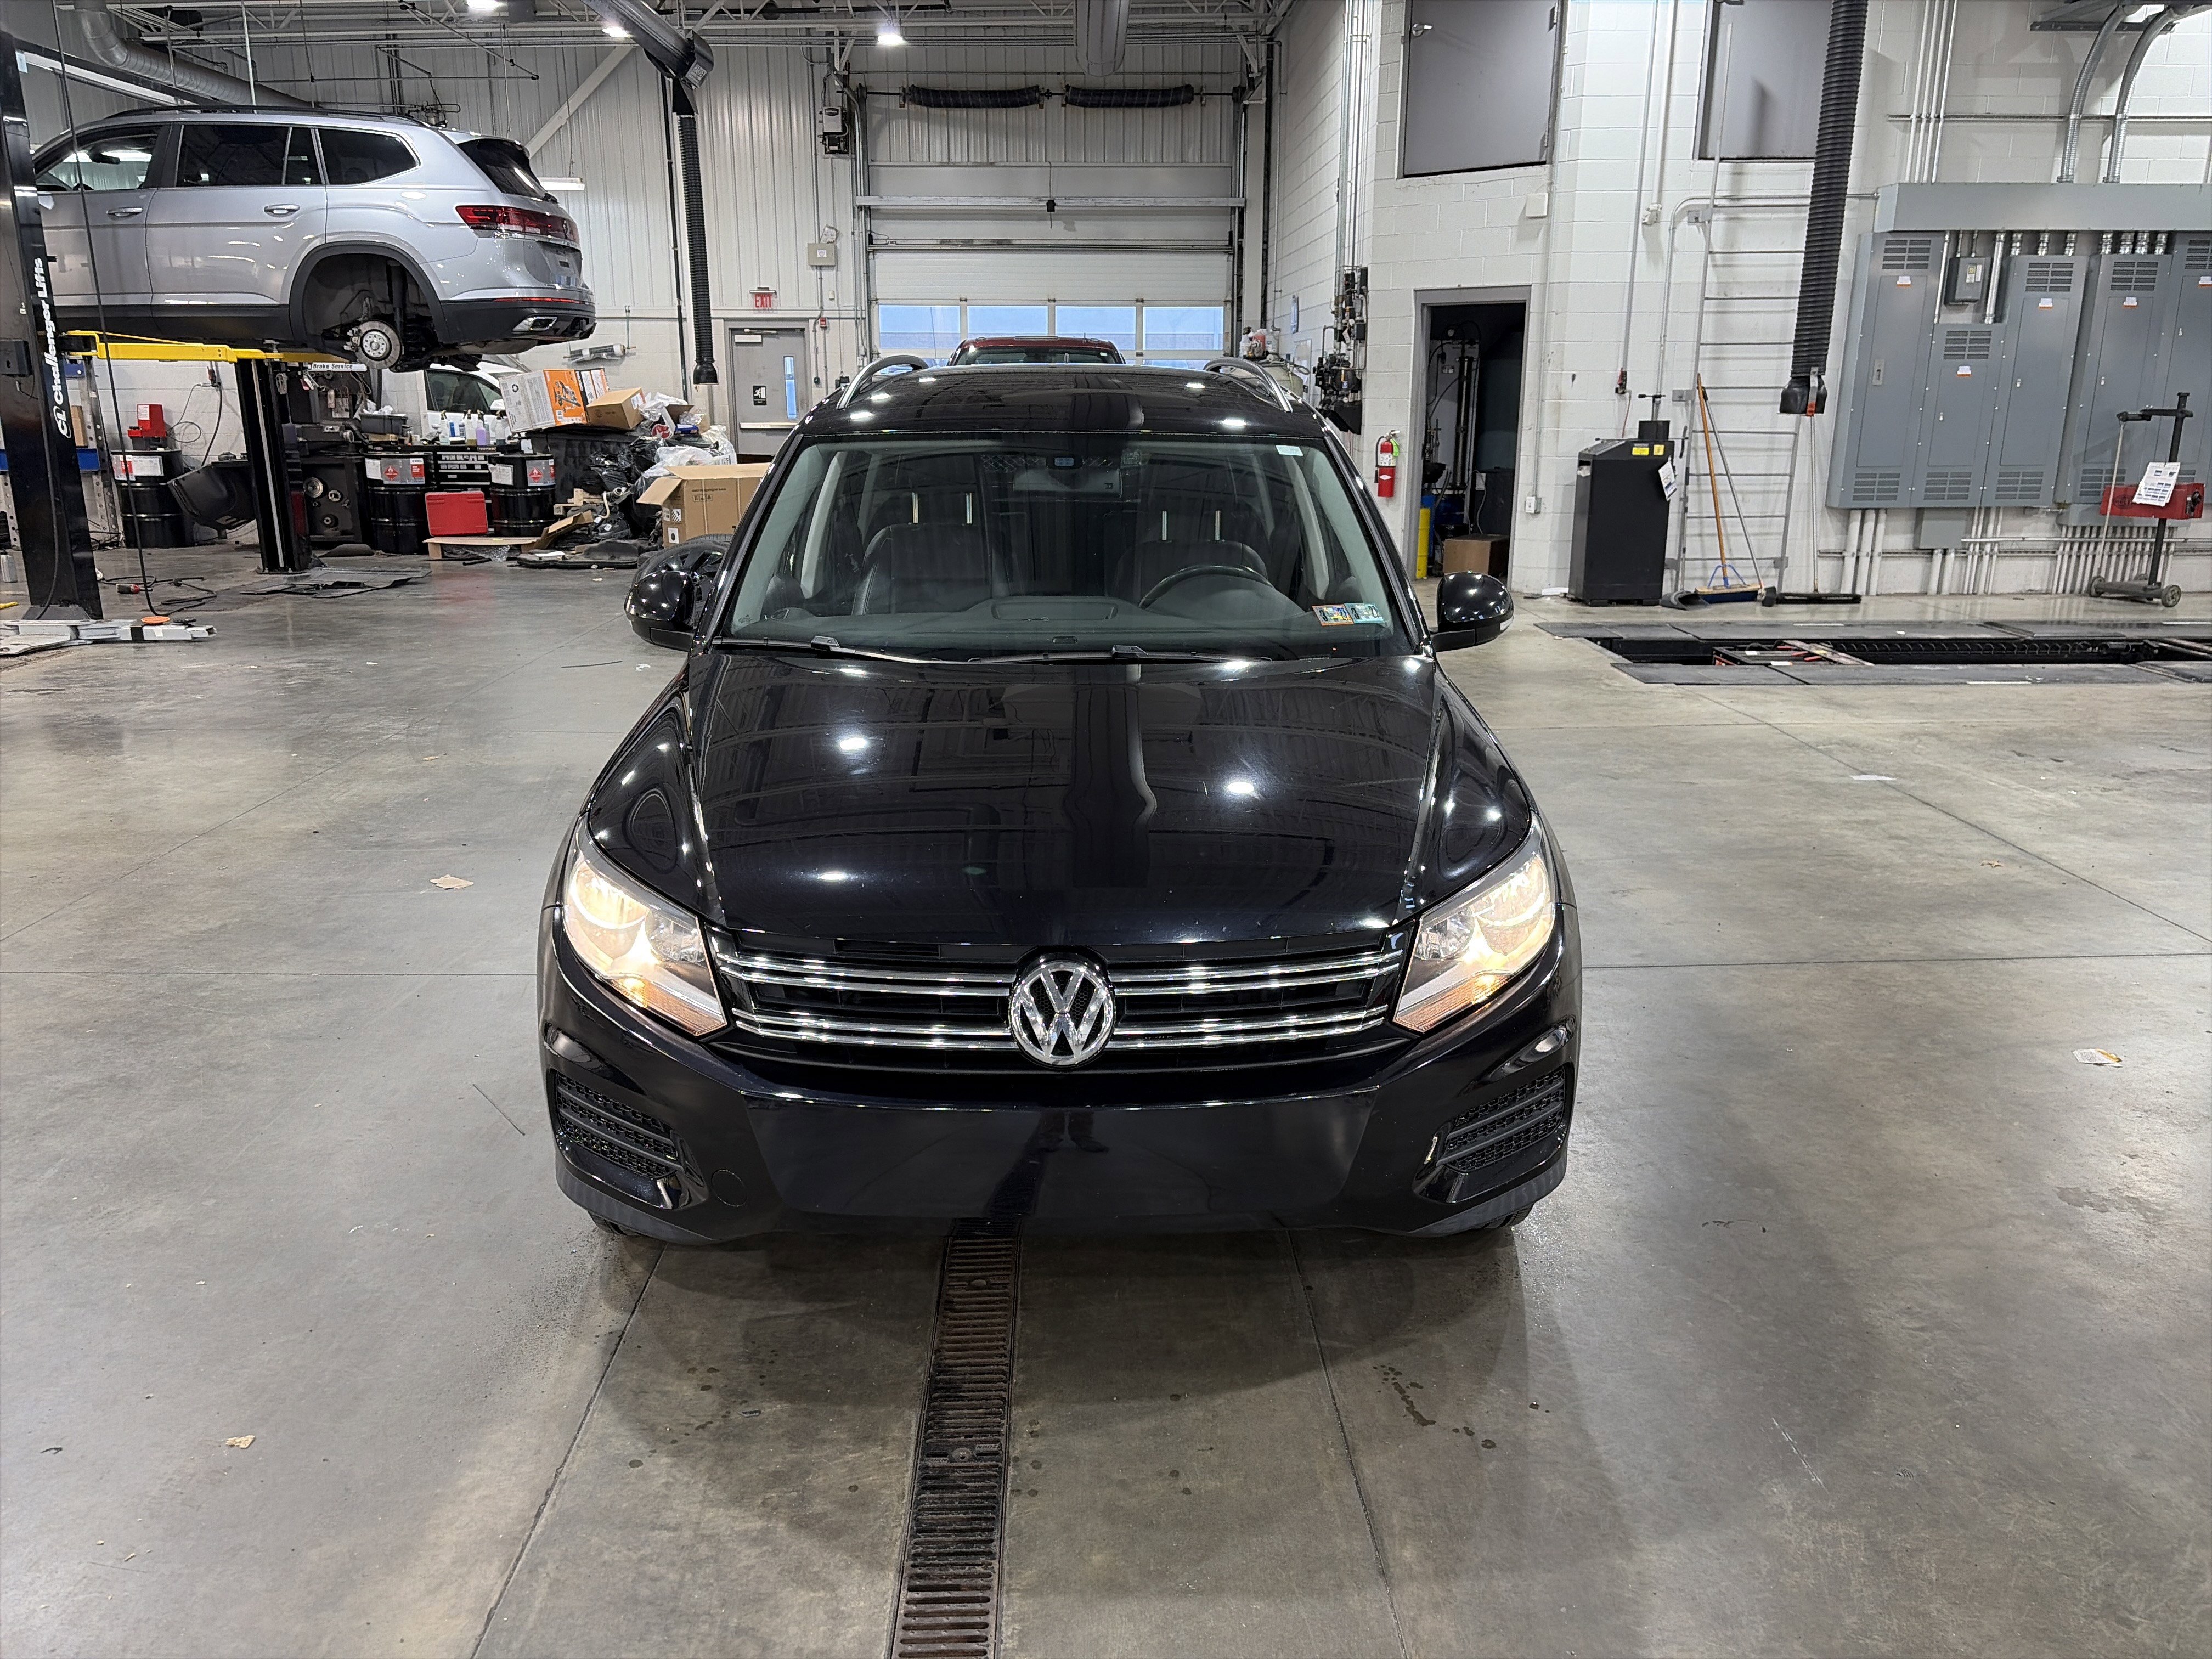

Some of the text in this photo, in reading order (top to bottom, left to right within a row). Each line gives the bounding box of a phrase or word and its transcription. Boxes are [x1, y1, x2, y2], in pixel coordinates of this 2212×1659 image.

[34, 257, 48, 298] Lifts
[755, 294, 772, 307] EXIT
[41, 300, 63, 405] Challenger
[1319, 610, 1328, 621] 3
[1351, 608, 1359, 619] 3
[1014, 963, 1111, 1064] VW
